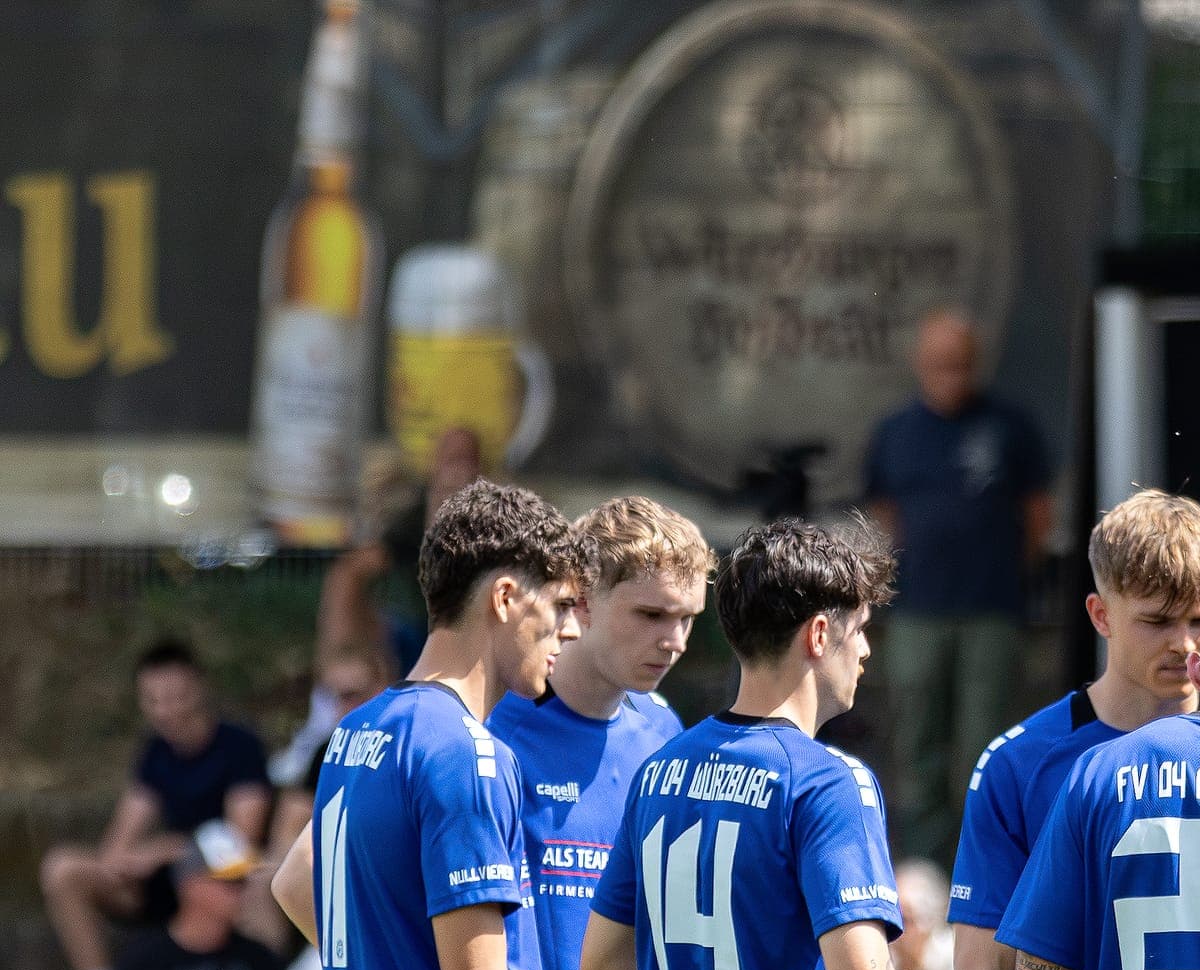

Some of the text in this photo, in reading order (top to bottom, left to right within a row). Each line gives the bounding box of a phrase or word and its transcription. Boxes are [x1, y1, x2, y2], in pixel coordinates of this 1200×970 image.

[640, 752, 780, 809] FV 04 WÜRZBURG
[1117, 761, 1149, 803] FV
[1158, 761, 1187, 799] 04
